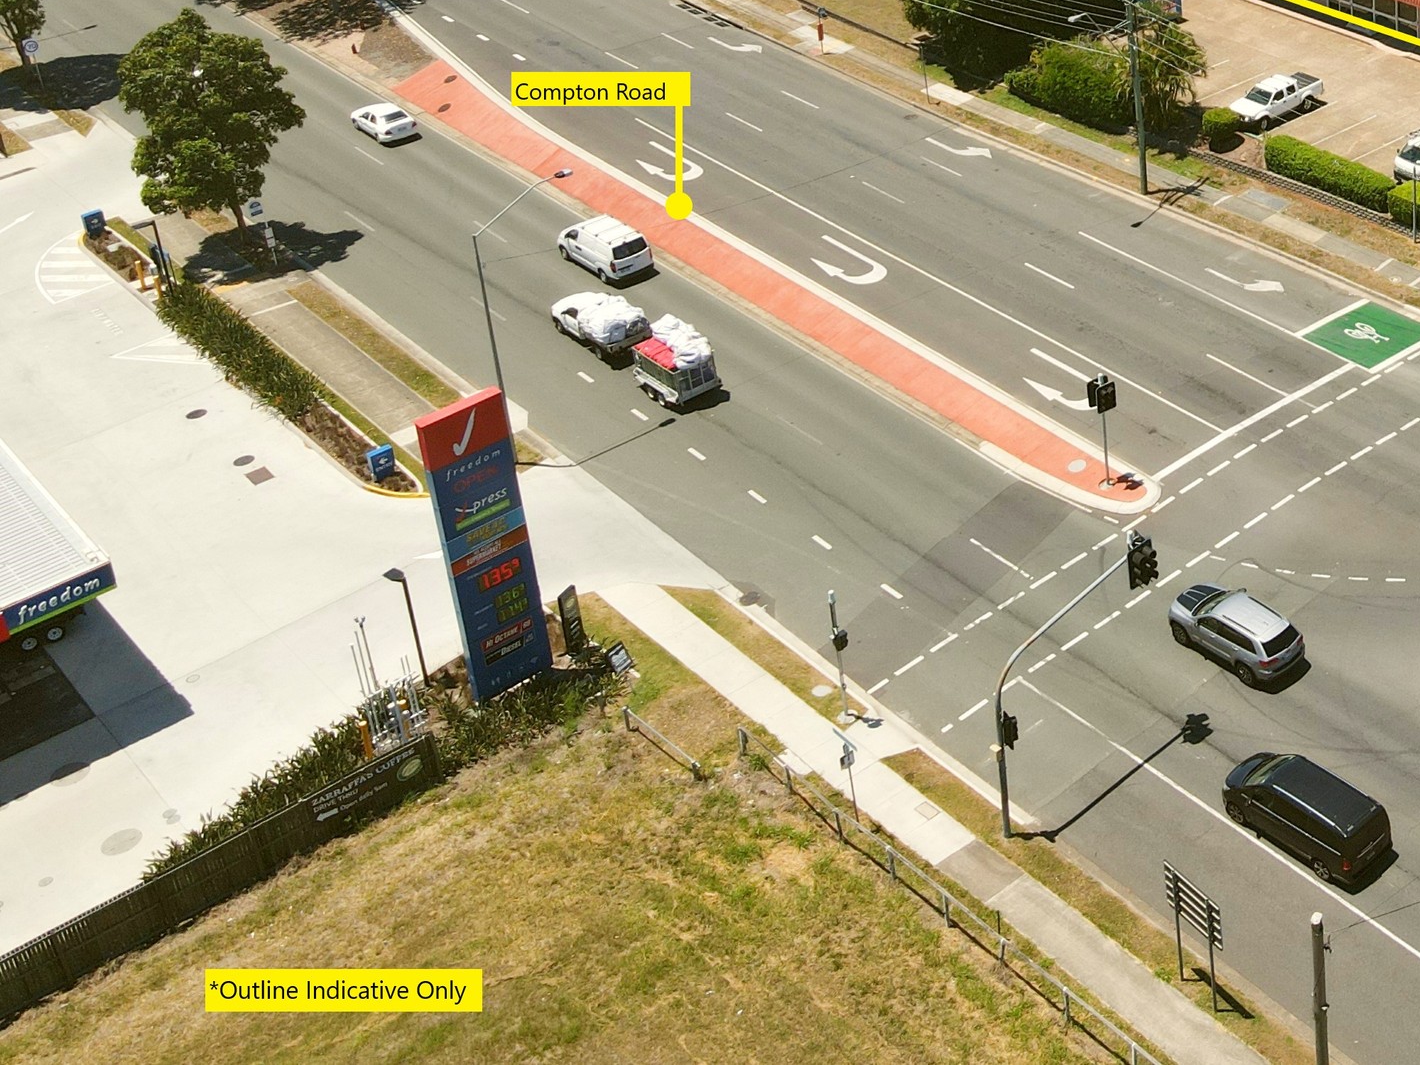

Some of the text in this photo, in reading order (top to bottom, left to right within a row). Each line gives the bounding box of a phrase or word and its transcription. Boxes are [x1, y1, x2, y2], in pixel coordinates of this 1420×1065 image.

[445, 449, 501, 481] freedom
[18, 578, 100, 624] freedom
[375, 747, 416, 774] COFFEE
[313, 800, 336, 813] DRIVE
